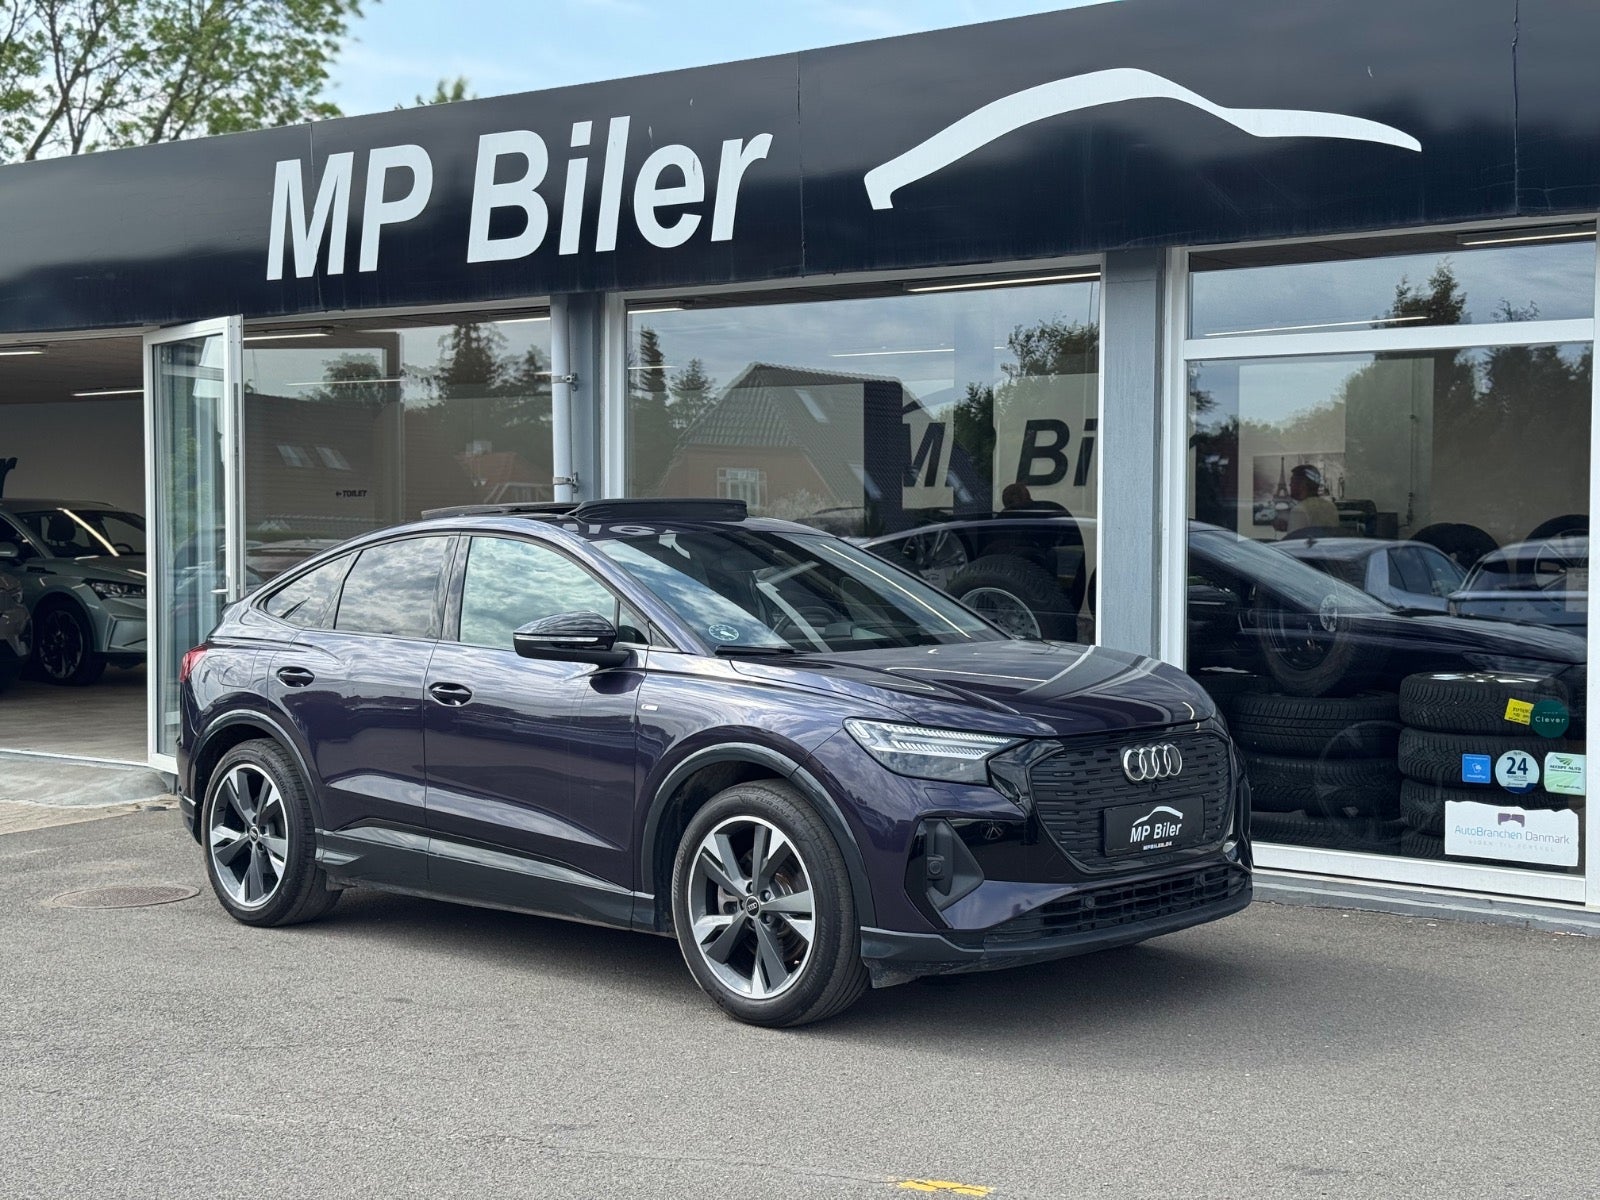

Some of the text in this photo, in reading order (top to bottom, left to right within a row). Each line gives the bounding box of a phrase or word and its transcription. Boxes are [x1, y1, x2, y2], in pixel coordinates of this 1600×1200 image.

[266, 115, 774, 281] MP Biler
[1535, 715, 1566, 724] Clever
[1506, 756, 1528, 776] 24
[1130, 821, 1182, 843] MP Biler
[1454, 825, 1570, 845] AutoBranchen Danmark
